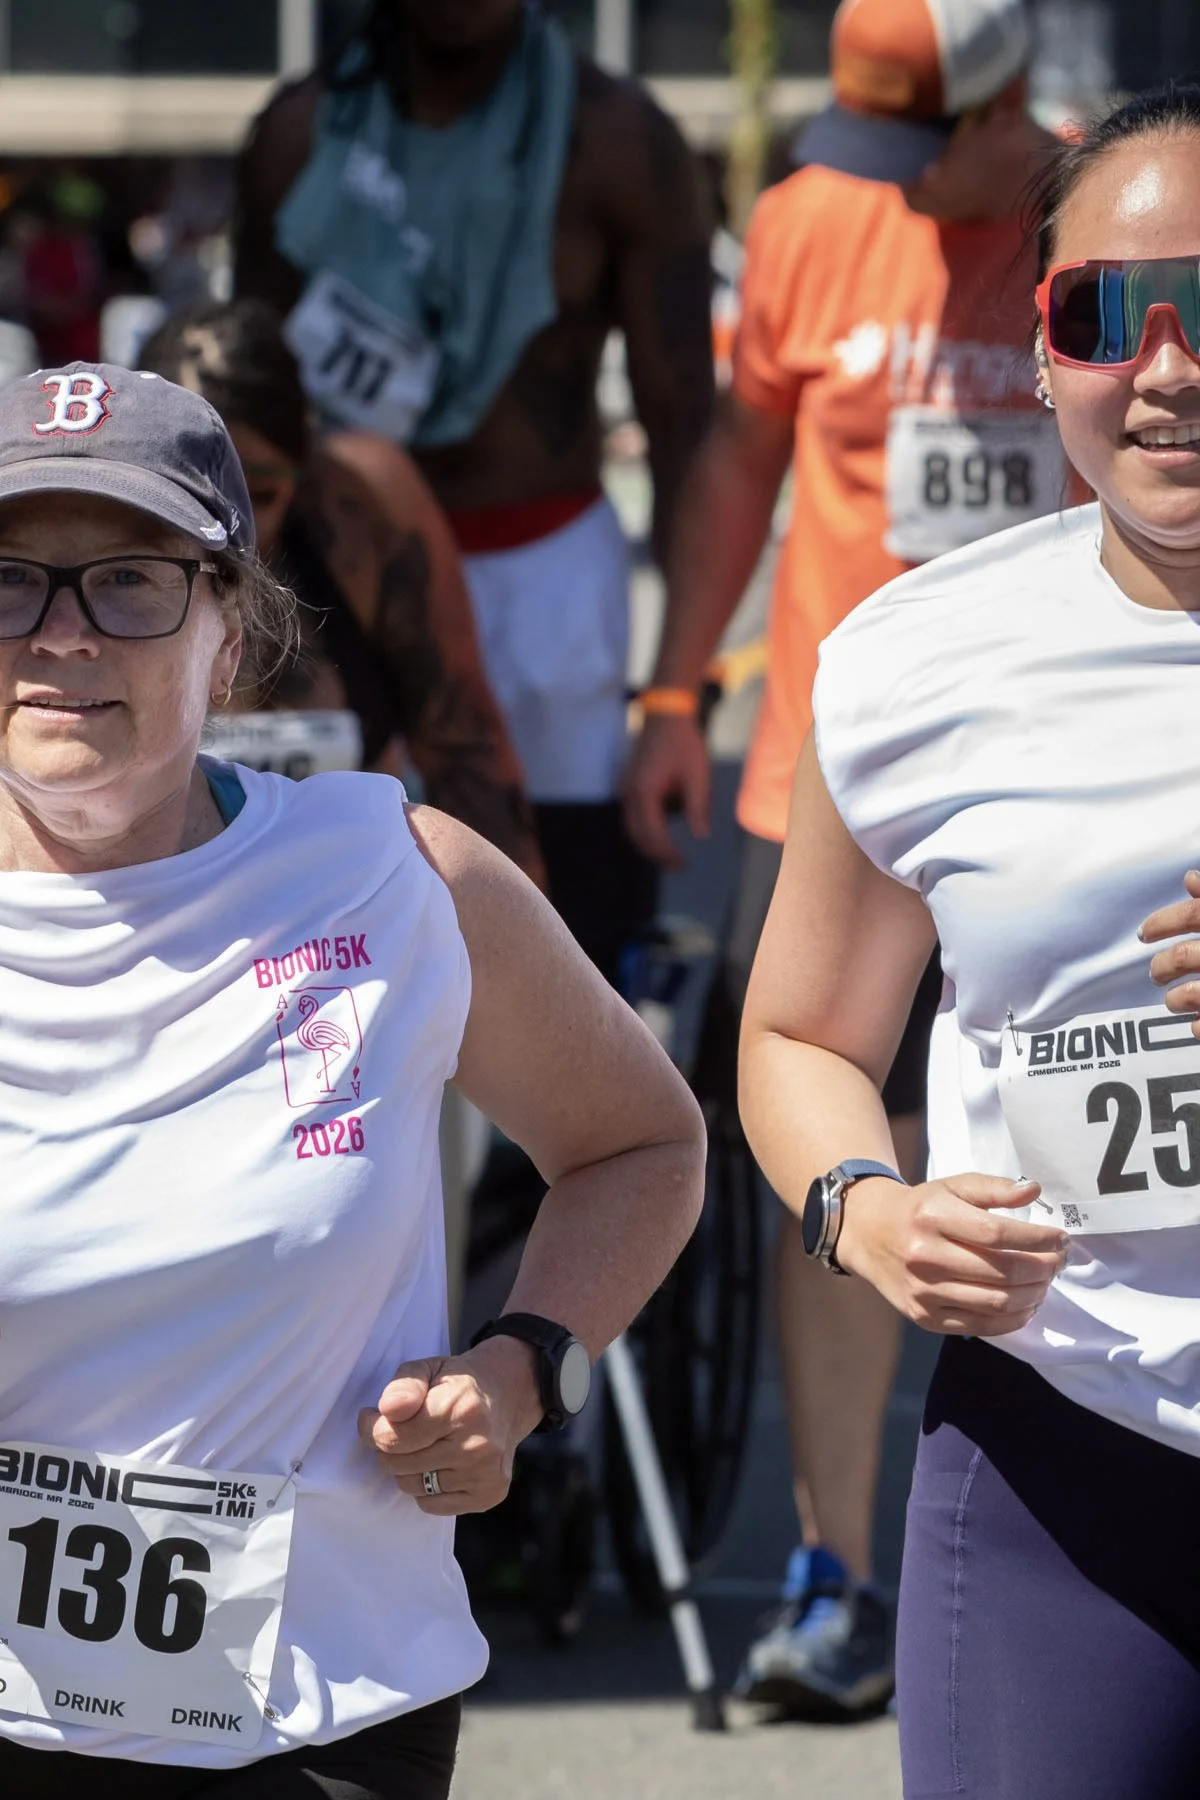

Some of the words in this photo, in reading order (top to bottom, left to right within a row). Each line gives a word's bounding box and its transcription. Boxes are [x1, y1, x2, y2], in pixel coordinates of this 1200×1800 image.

[32, 371, 116, 438] B
[925, 451, 1031, 509] 898
[276, 993, 288, 1009] A
[1028, 1065, 1078, 1077] CAMBRIDGE
[1080, 1063, 1094, 1071] MA
[1098, 1060, 1121, 1069] 2026
[293, 1116, 365, 1159] 2026
[46, 1494, 63, 1504] MA
[68, 1498, 95, 1510] 2026
[8, 1516, 211, 1654] 136
[54, 1689, 126, 1718] DRINK
[171, 1708, 243, 1733] DRINK
